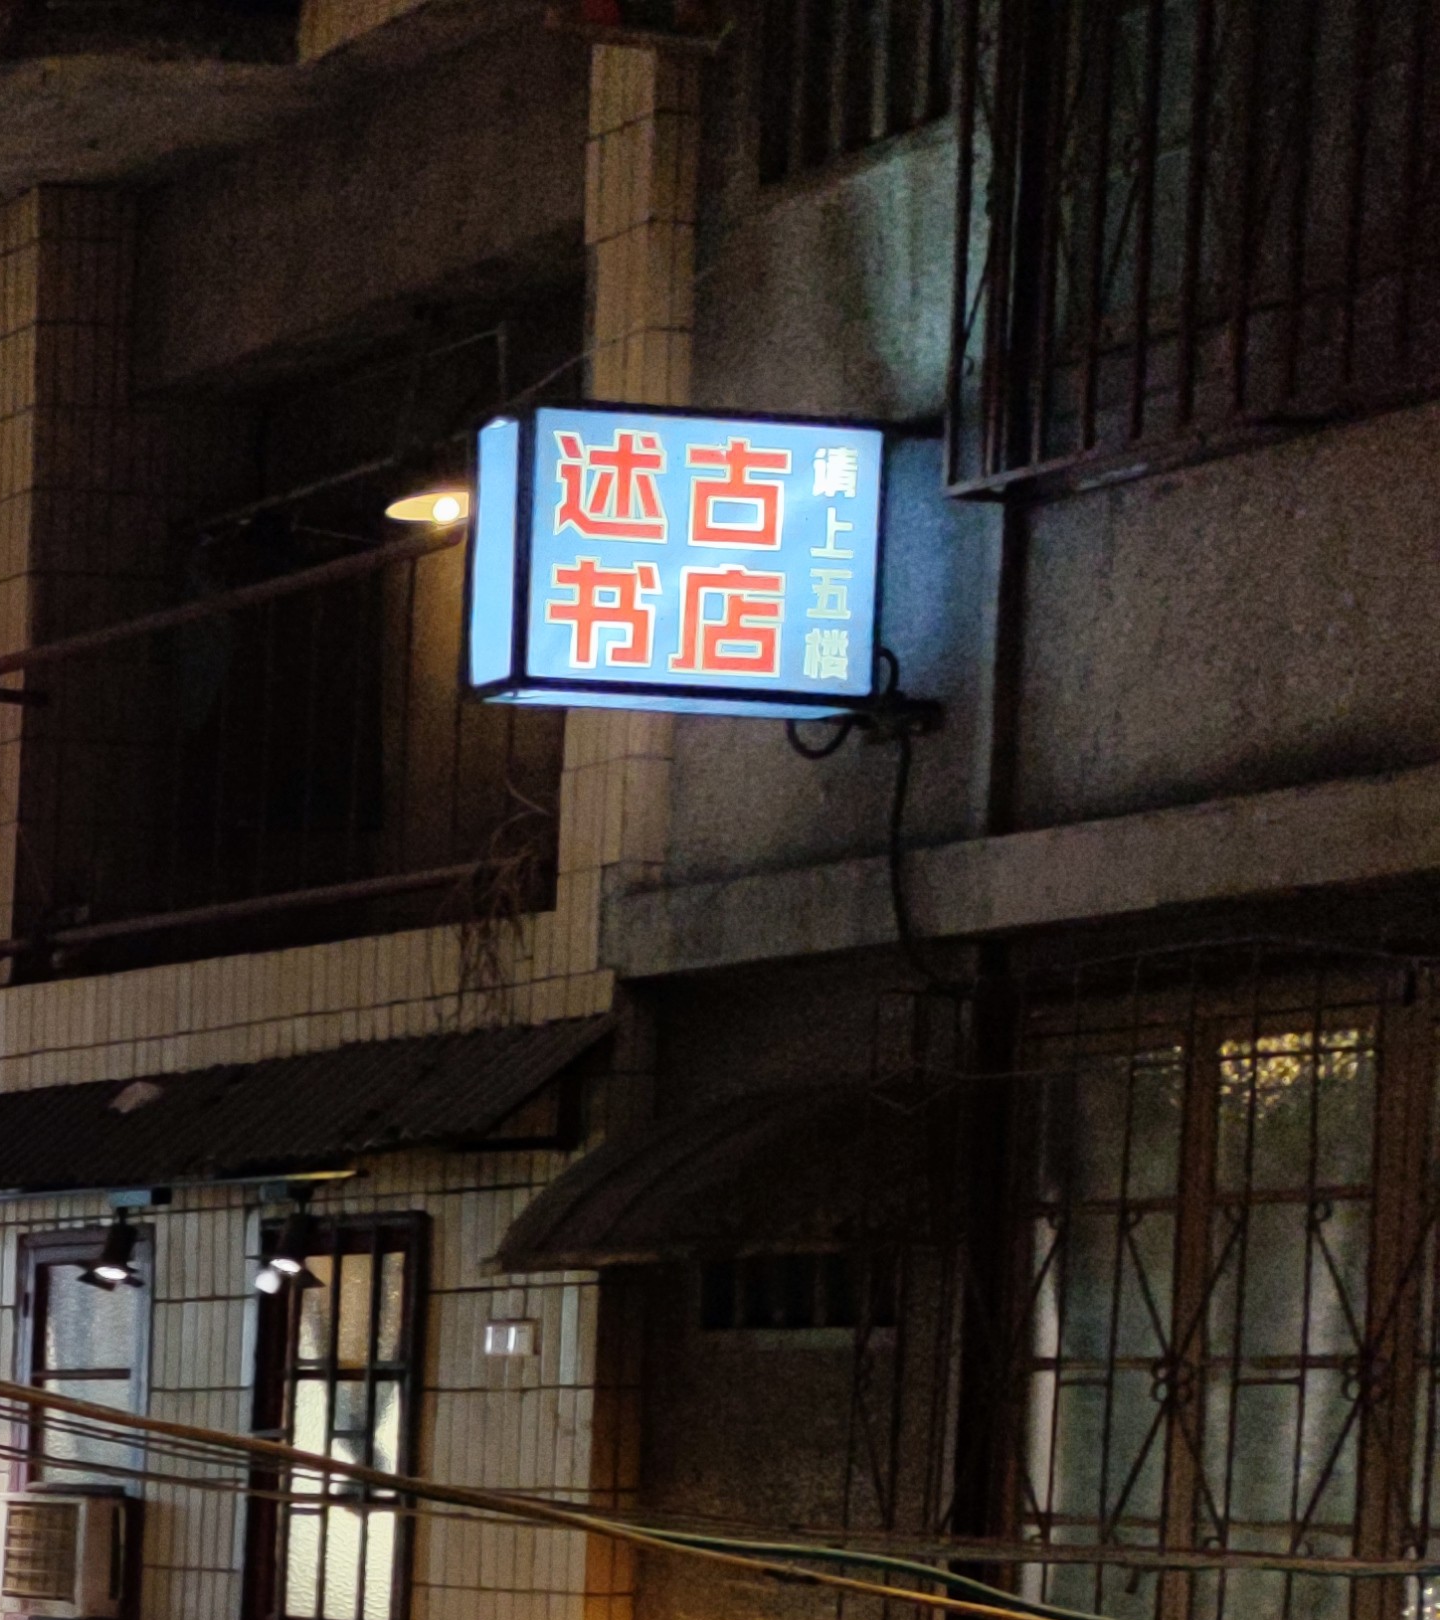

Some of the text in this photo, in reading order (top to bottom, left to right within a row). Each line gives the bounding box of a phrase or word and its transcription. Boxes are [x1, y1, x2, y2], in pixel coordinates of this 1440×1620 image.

[553, 428, 793, 551] 述古
[544, 555, 786, 678] 书店
[802, 446, 859, 682] 请上五楼
